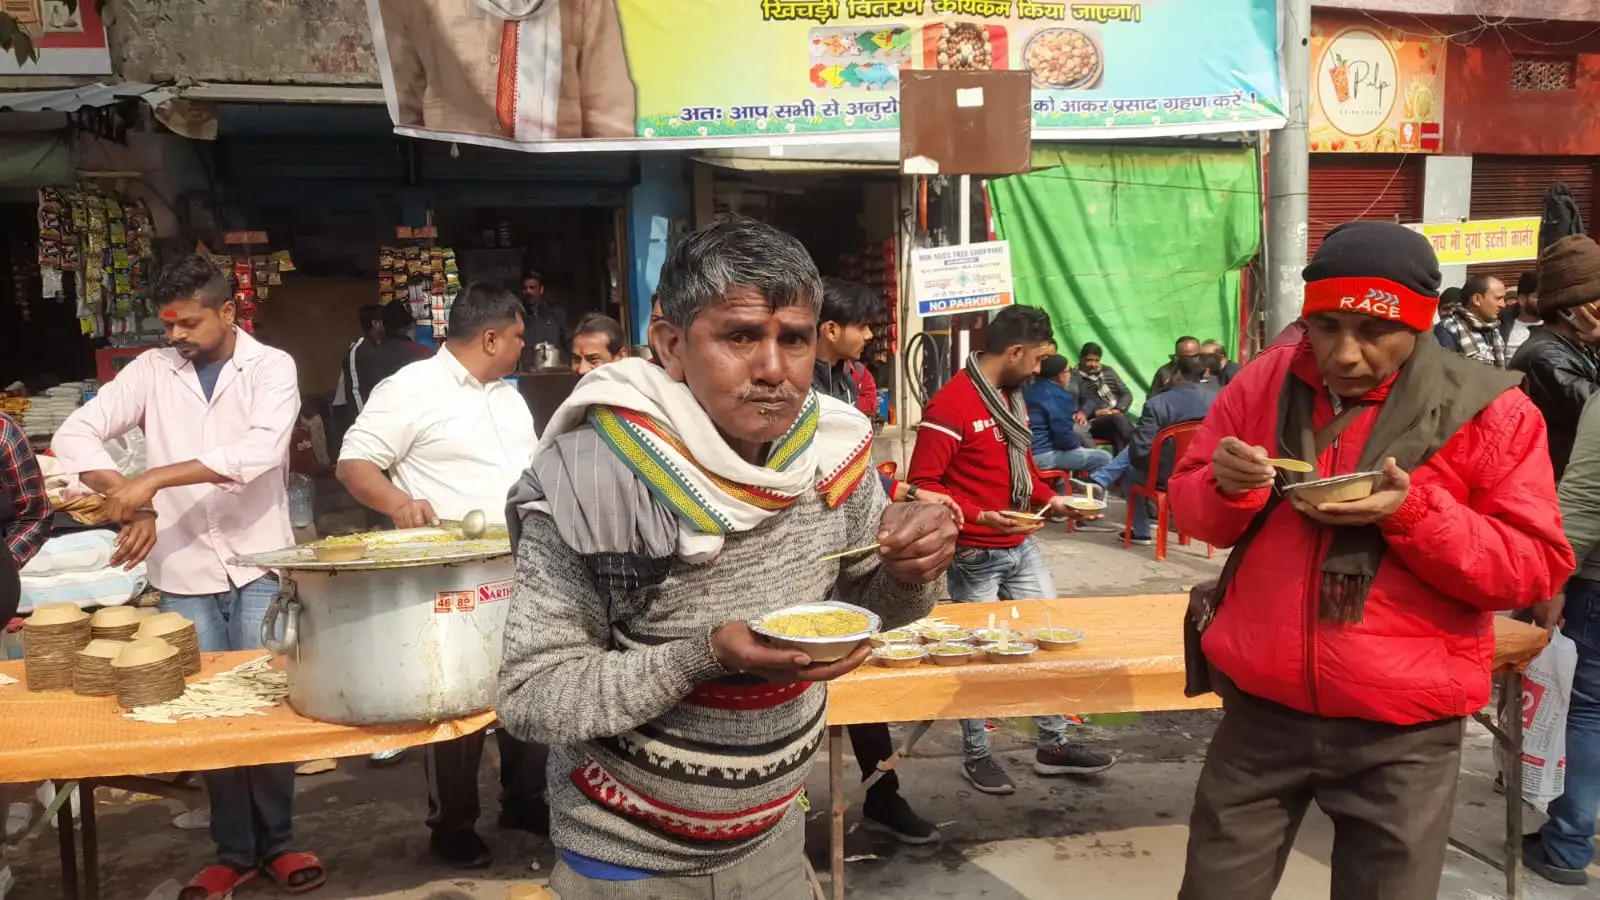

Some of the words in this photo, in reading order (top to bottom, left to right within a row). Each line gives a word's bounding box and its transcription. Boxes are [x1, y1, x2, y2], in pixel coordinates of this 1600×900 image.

[1348, 60, 1391, 108] Pulp
[680, 106, 722, 121] अतः
[729, 105, 769, 120] आप
[775, 98, 816, 118] सभी
[822, 98, 840, 116] से
[1033, 96, 1056, 113] को
[1060, 98, 1108, 113] आकर
[1112, 98, 1158, 114] प्रसाद
[1163, 95, 1207, 112] ग्रहण
[1213, 91, 1244, 107] करें
[929, 301, 947, 312] NO
[949, 295, 1001, 309] PARKING
[1340, 296, 1401, 318] RACE
[438, 598, 451, 607] 46
